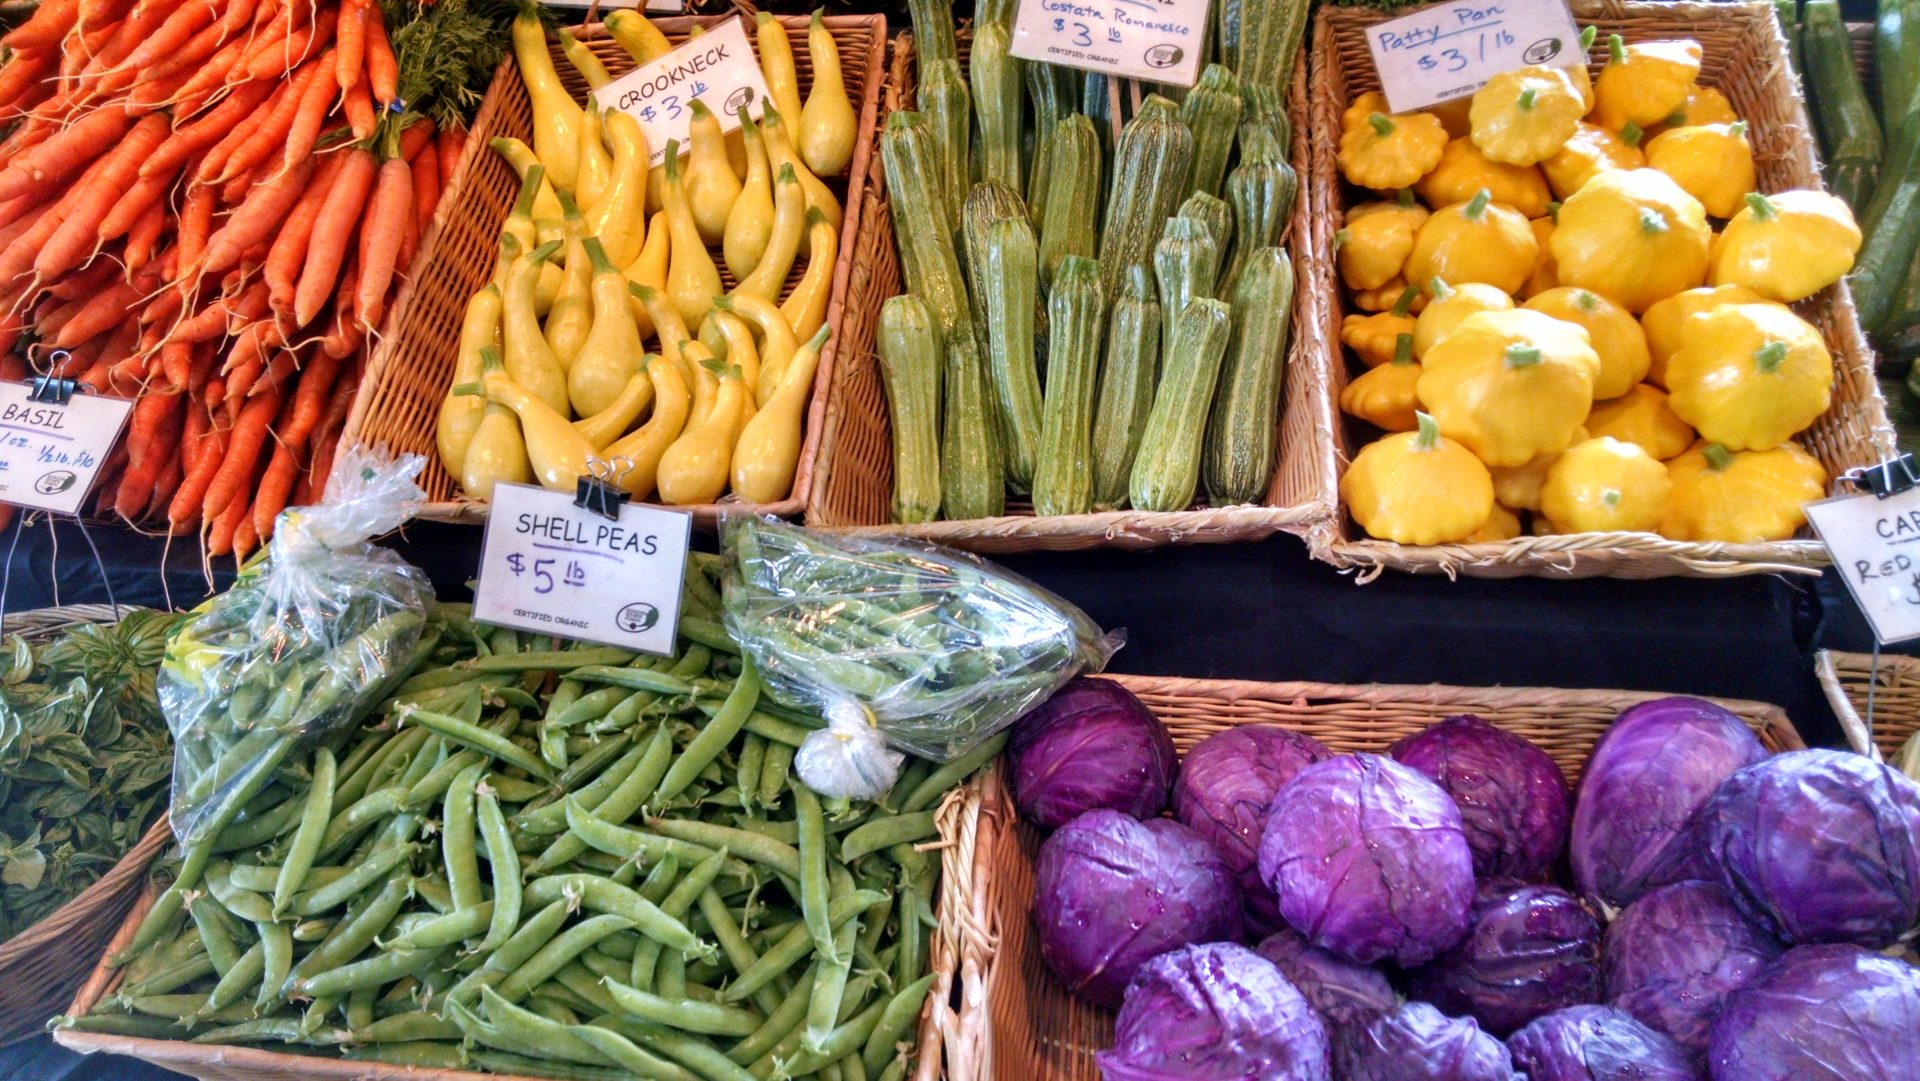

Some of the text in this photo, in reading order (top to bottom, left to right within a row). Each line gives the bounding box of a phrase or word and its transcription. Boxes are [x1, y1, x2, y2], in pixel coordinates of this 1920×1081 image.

[1042, 0, 1190, 36] Costata Romanesco
[1379, 6, 1504, 52] Patty Pan
[1048, 46, 1120, 66] CERTIFIED ORGANIC
[619, 43, 730, 110] CROOKNECK
[2, 403, 65, 429] BASIL
[515, 512, 659, 556] SHELL PEAS
[1855, 554, 1912, 585] RED
[512, 608, 590, 629] CERTIFIED ORGANIC
